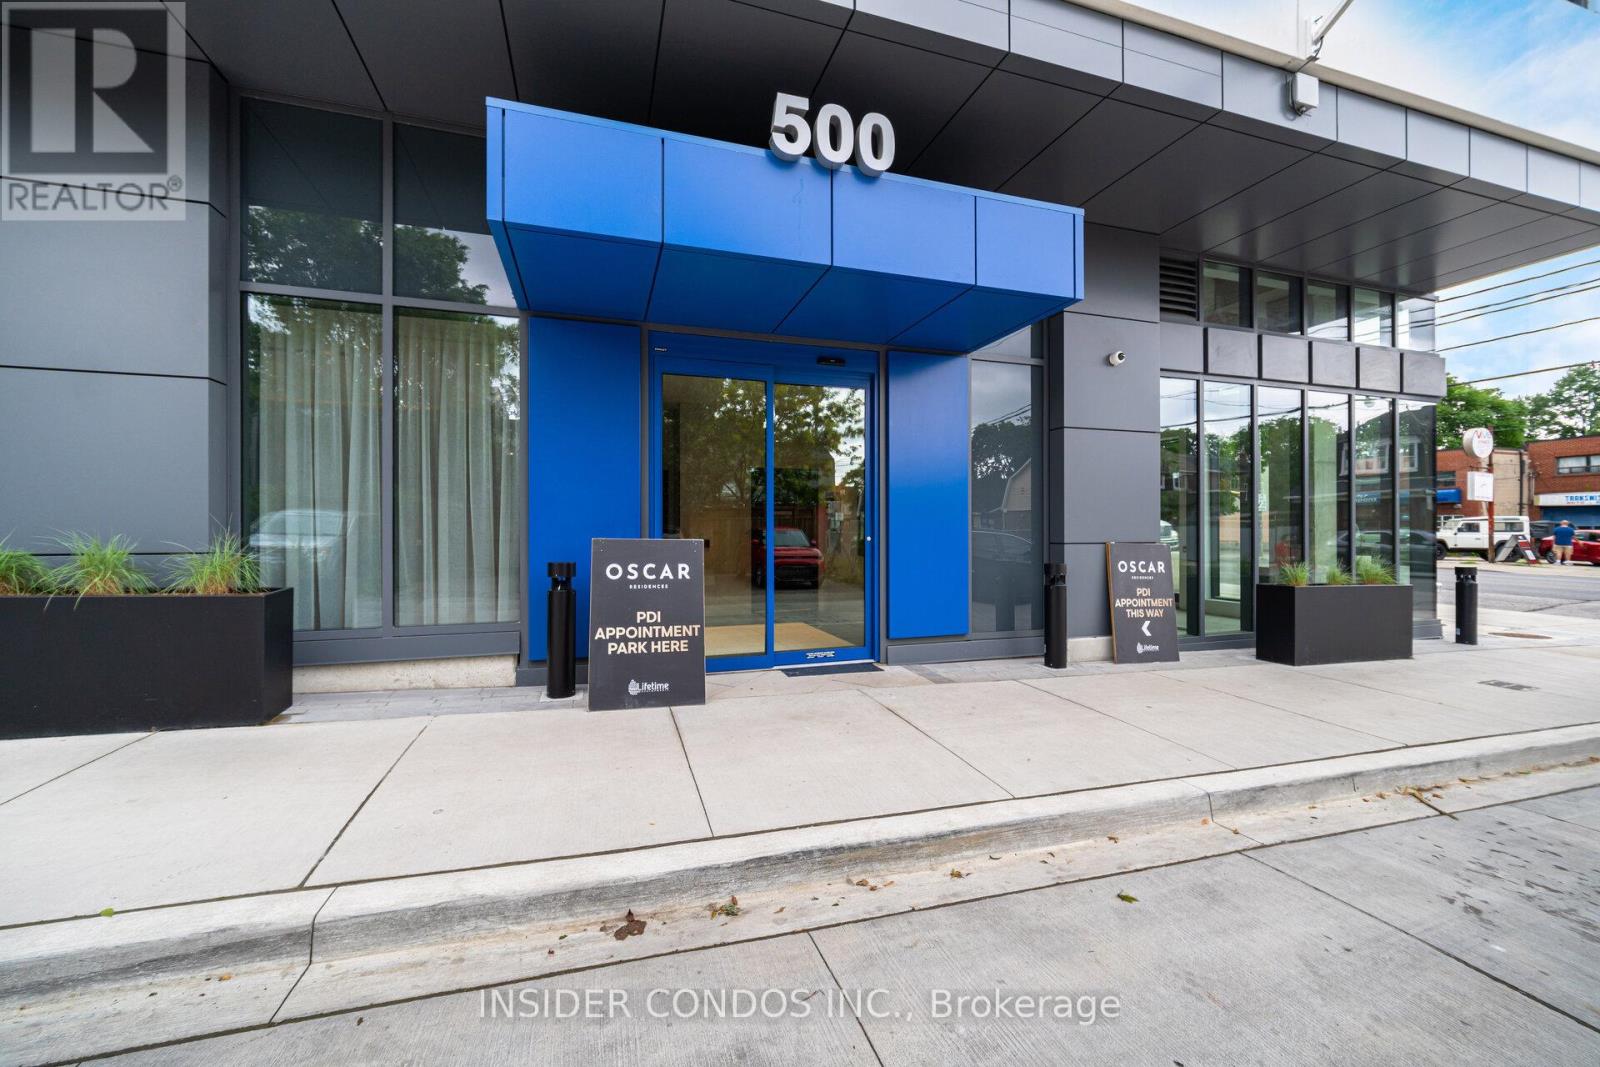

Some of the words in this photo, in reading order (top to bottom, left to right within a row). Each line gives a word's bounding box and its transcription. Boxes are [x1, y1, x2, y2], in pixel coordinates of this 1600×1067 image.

[769, 92, 895, 177] 500
[605, 563, 690, 580] OSCAR
[1118, 560, 1165, 573] OSCAR
[1136, 588, 1151, 597] PDI
[1115, 598, 1173, 607] APPOINTMENT
[636, 611, 661, 623] PDI
[1126, 609, 1144, 618] THIS
[1146, 609, 1164, 618] WAY
[594, 624, 700, 640] APPOINTMENT
[607, 641, 647, 655] PARK
[651, 640, 689, 653] HERE
[637, 681, 669, 691] Lifetime
